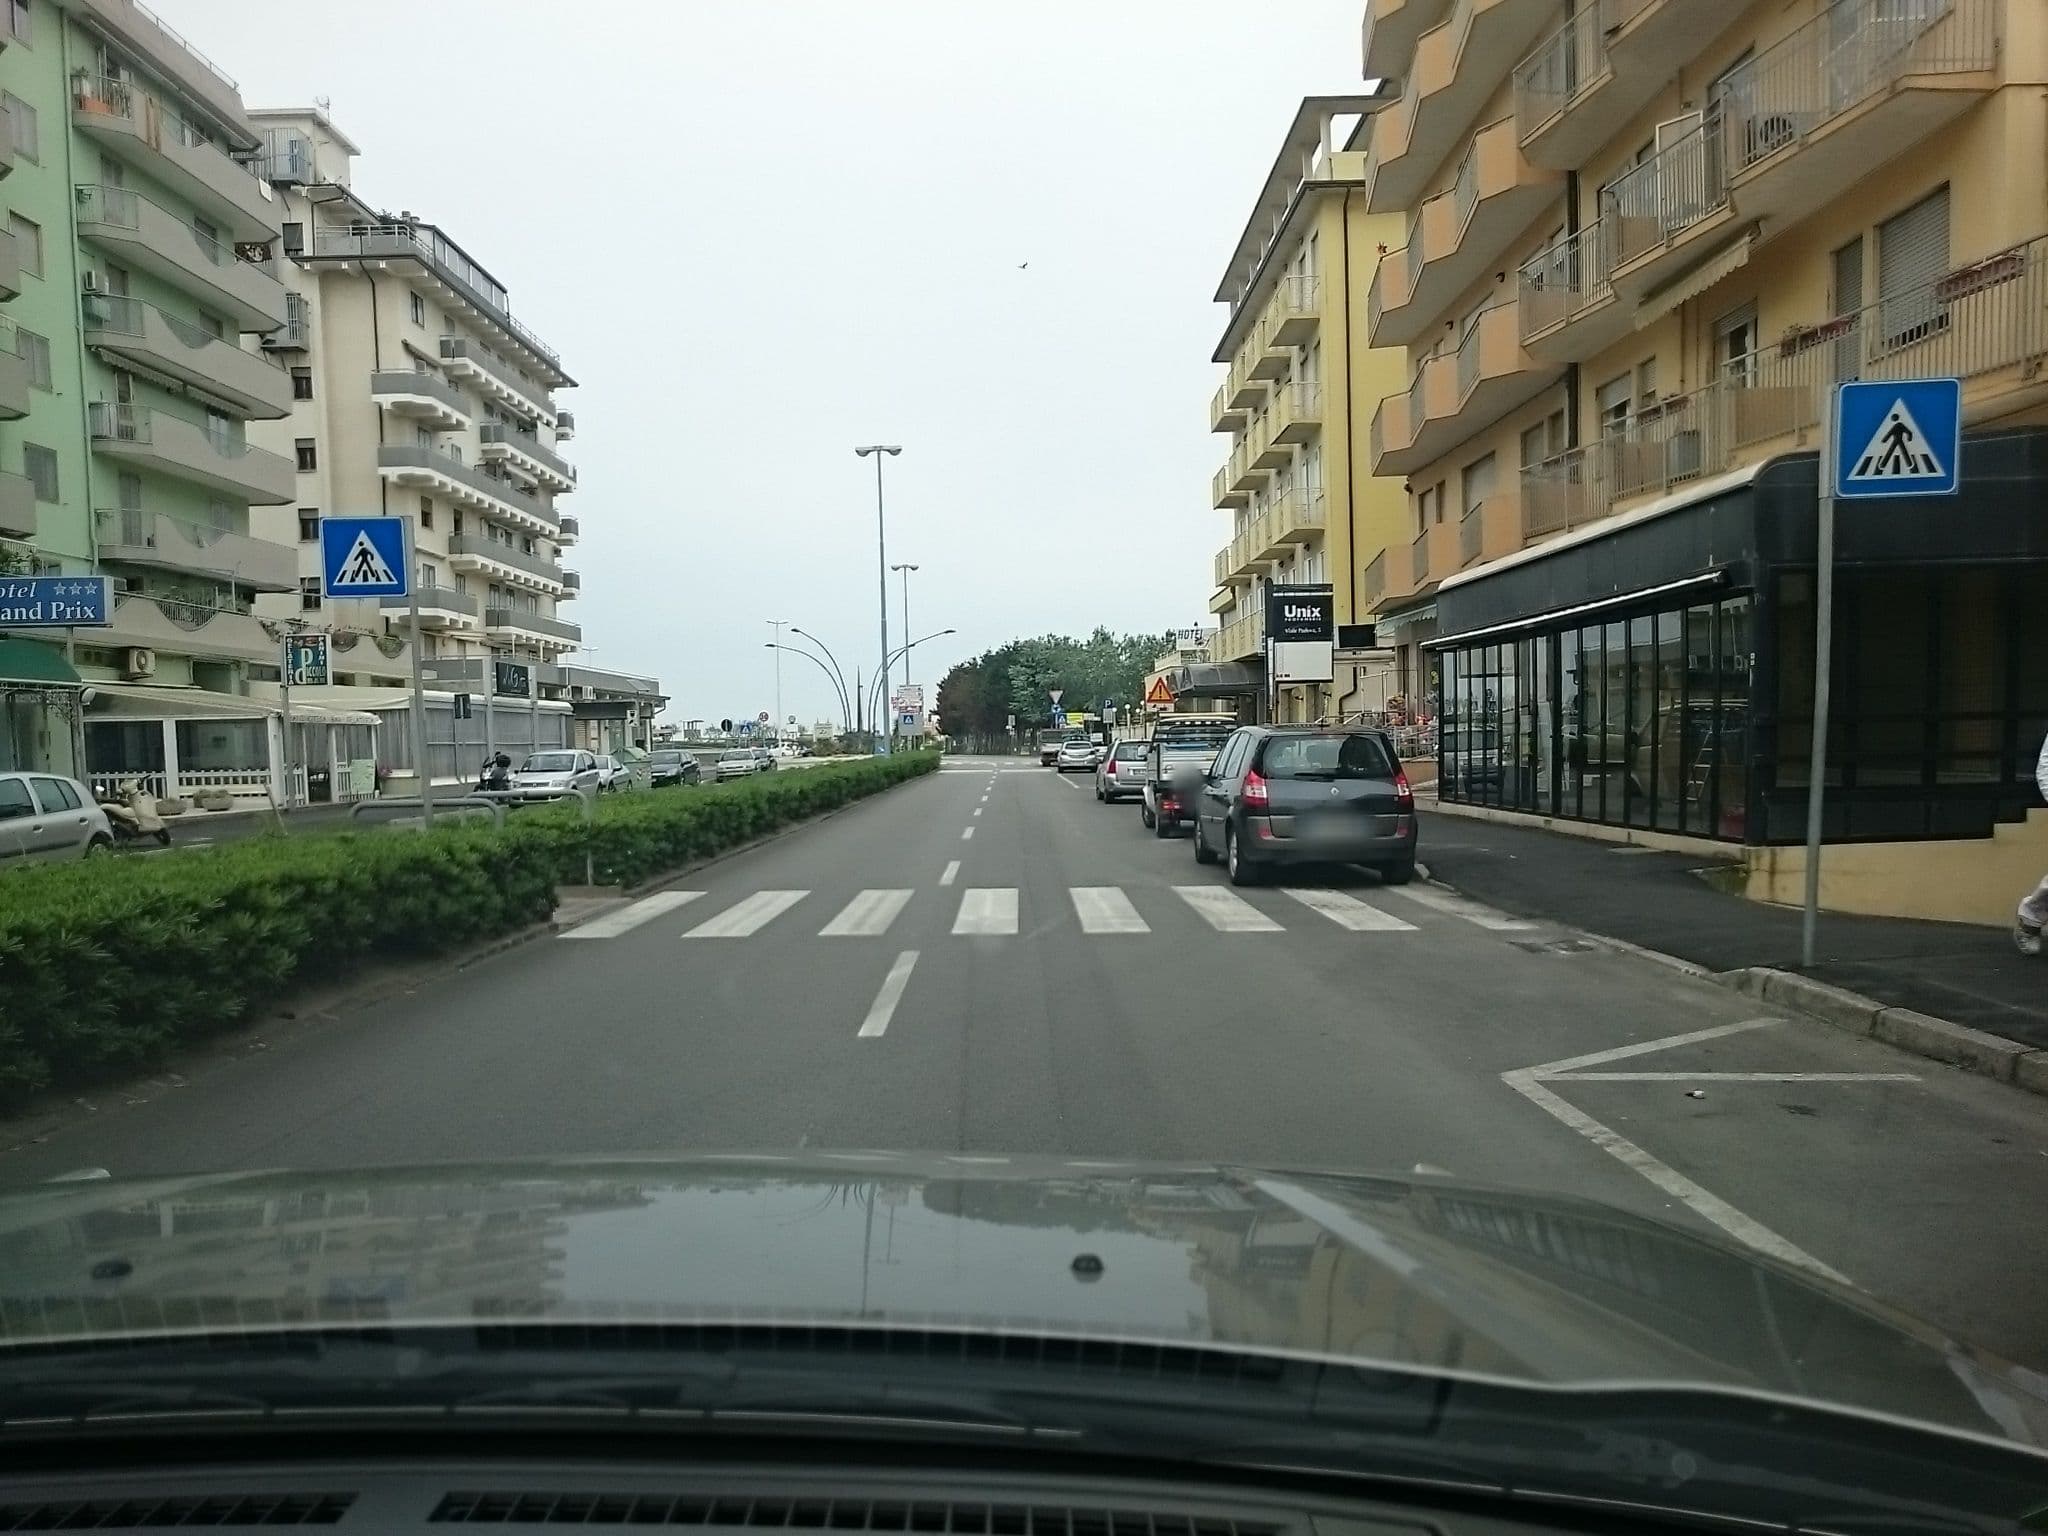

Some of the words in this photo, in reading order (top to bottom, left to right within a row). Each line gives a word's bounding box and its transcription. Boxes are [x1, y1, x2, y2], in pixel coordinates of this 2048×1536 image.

[50, 601, 96, 620] Prix
[1284, 604, 1321, 618] Unix
[1177, 629, 1203, 640] HOTEL
